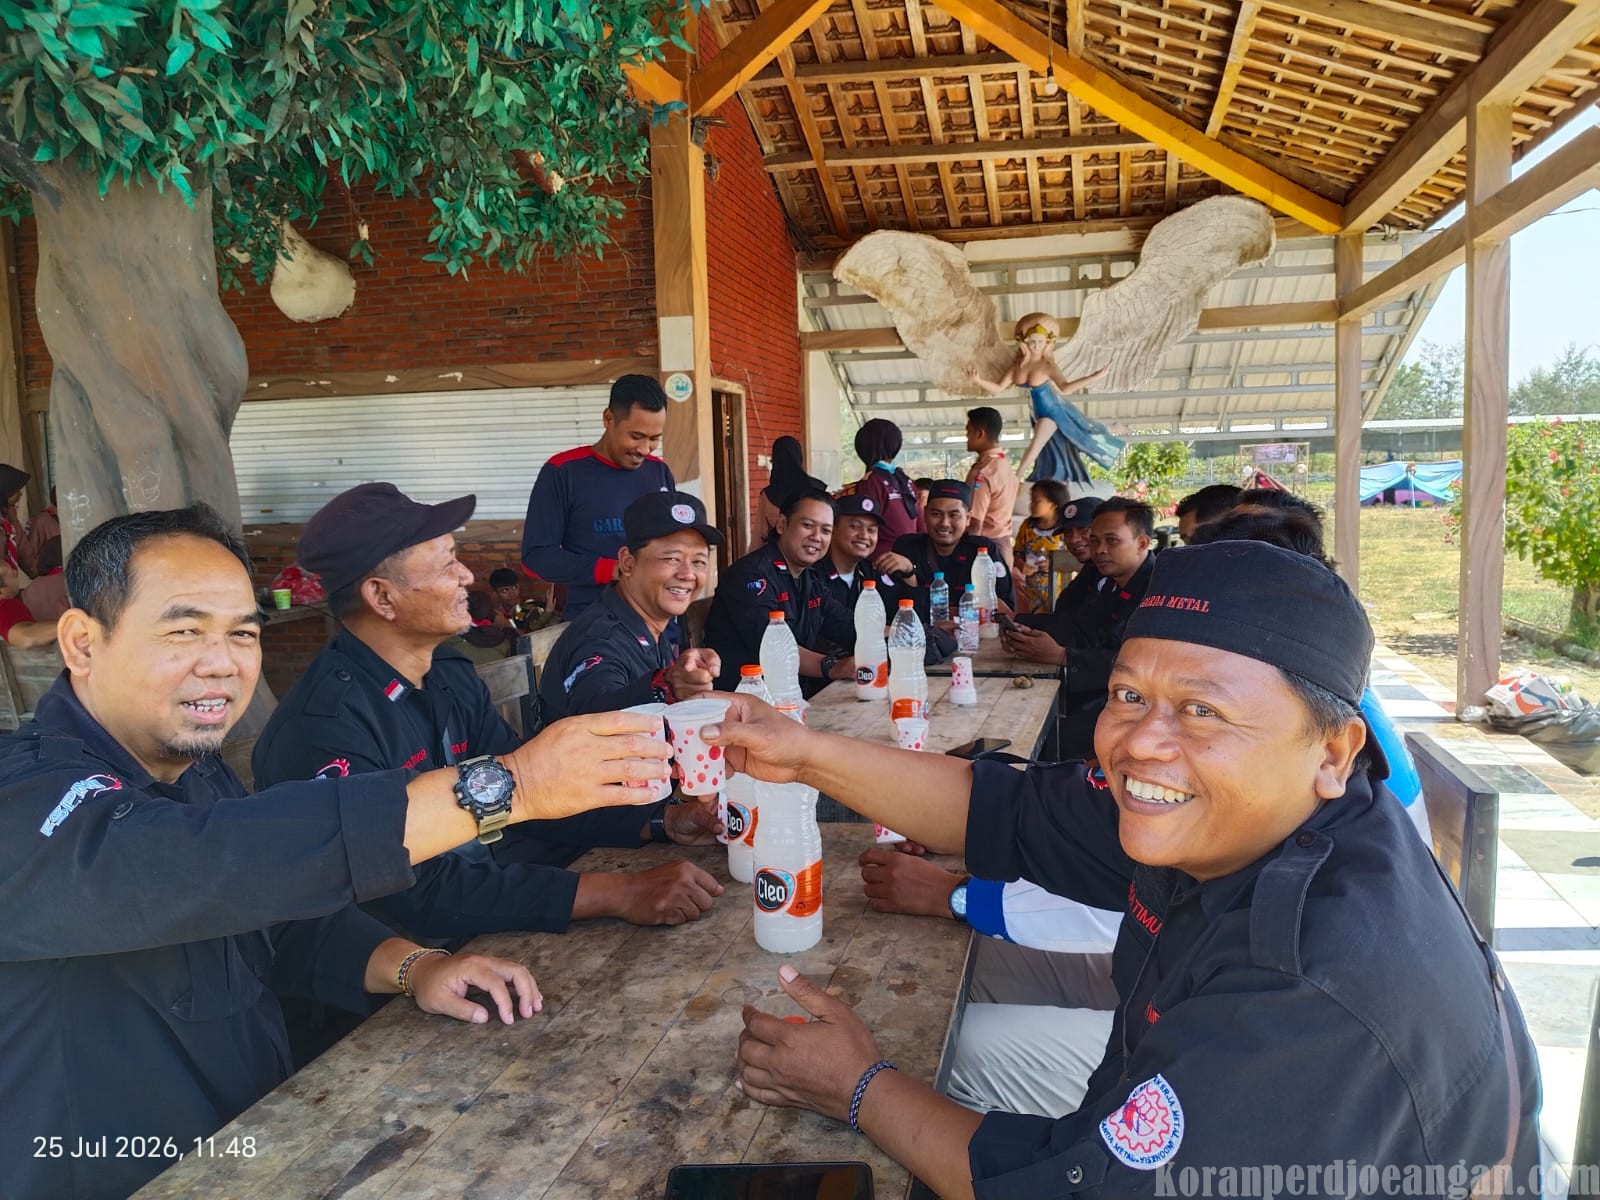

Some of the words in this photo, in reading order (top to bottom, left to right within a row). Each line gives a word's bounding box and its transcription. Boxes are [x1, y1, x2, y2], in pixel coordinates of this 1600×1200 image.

[1166, 596, 1210, 613] METAL
[858, 670, 873, 680] Cleo
[727, 811, 743, 832] leo
[758, 877, 785, 902] Cleo
[1132, 898, 1163, 935] TIMU
[1171, 1110, 1181, 1138] METAL
